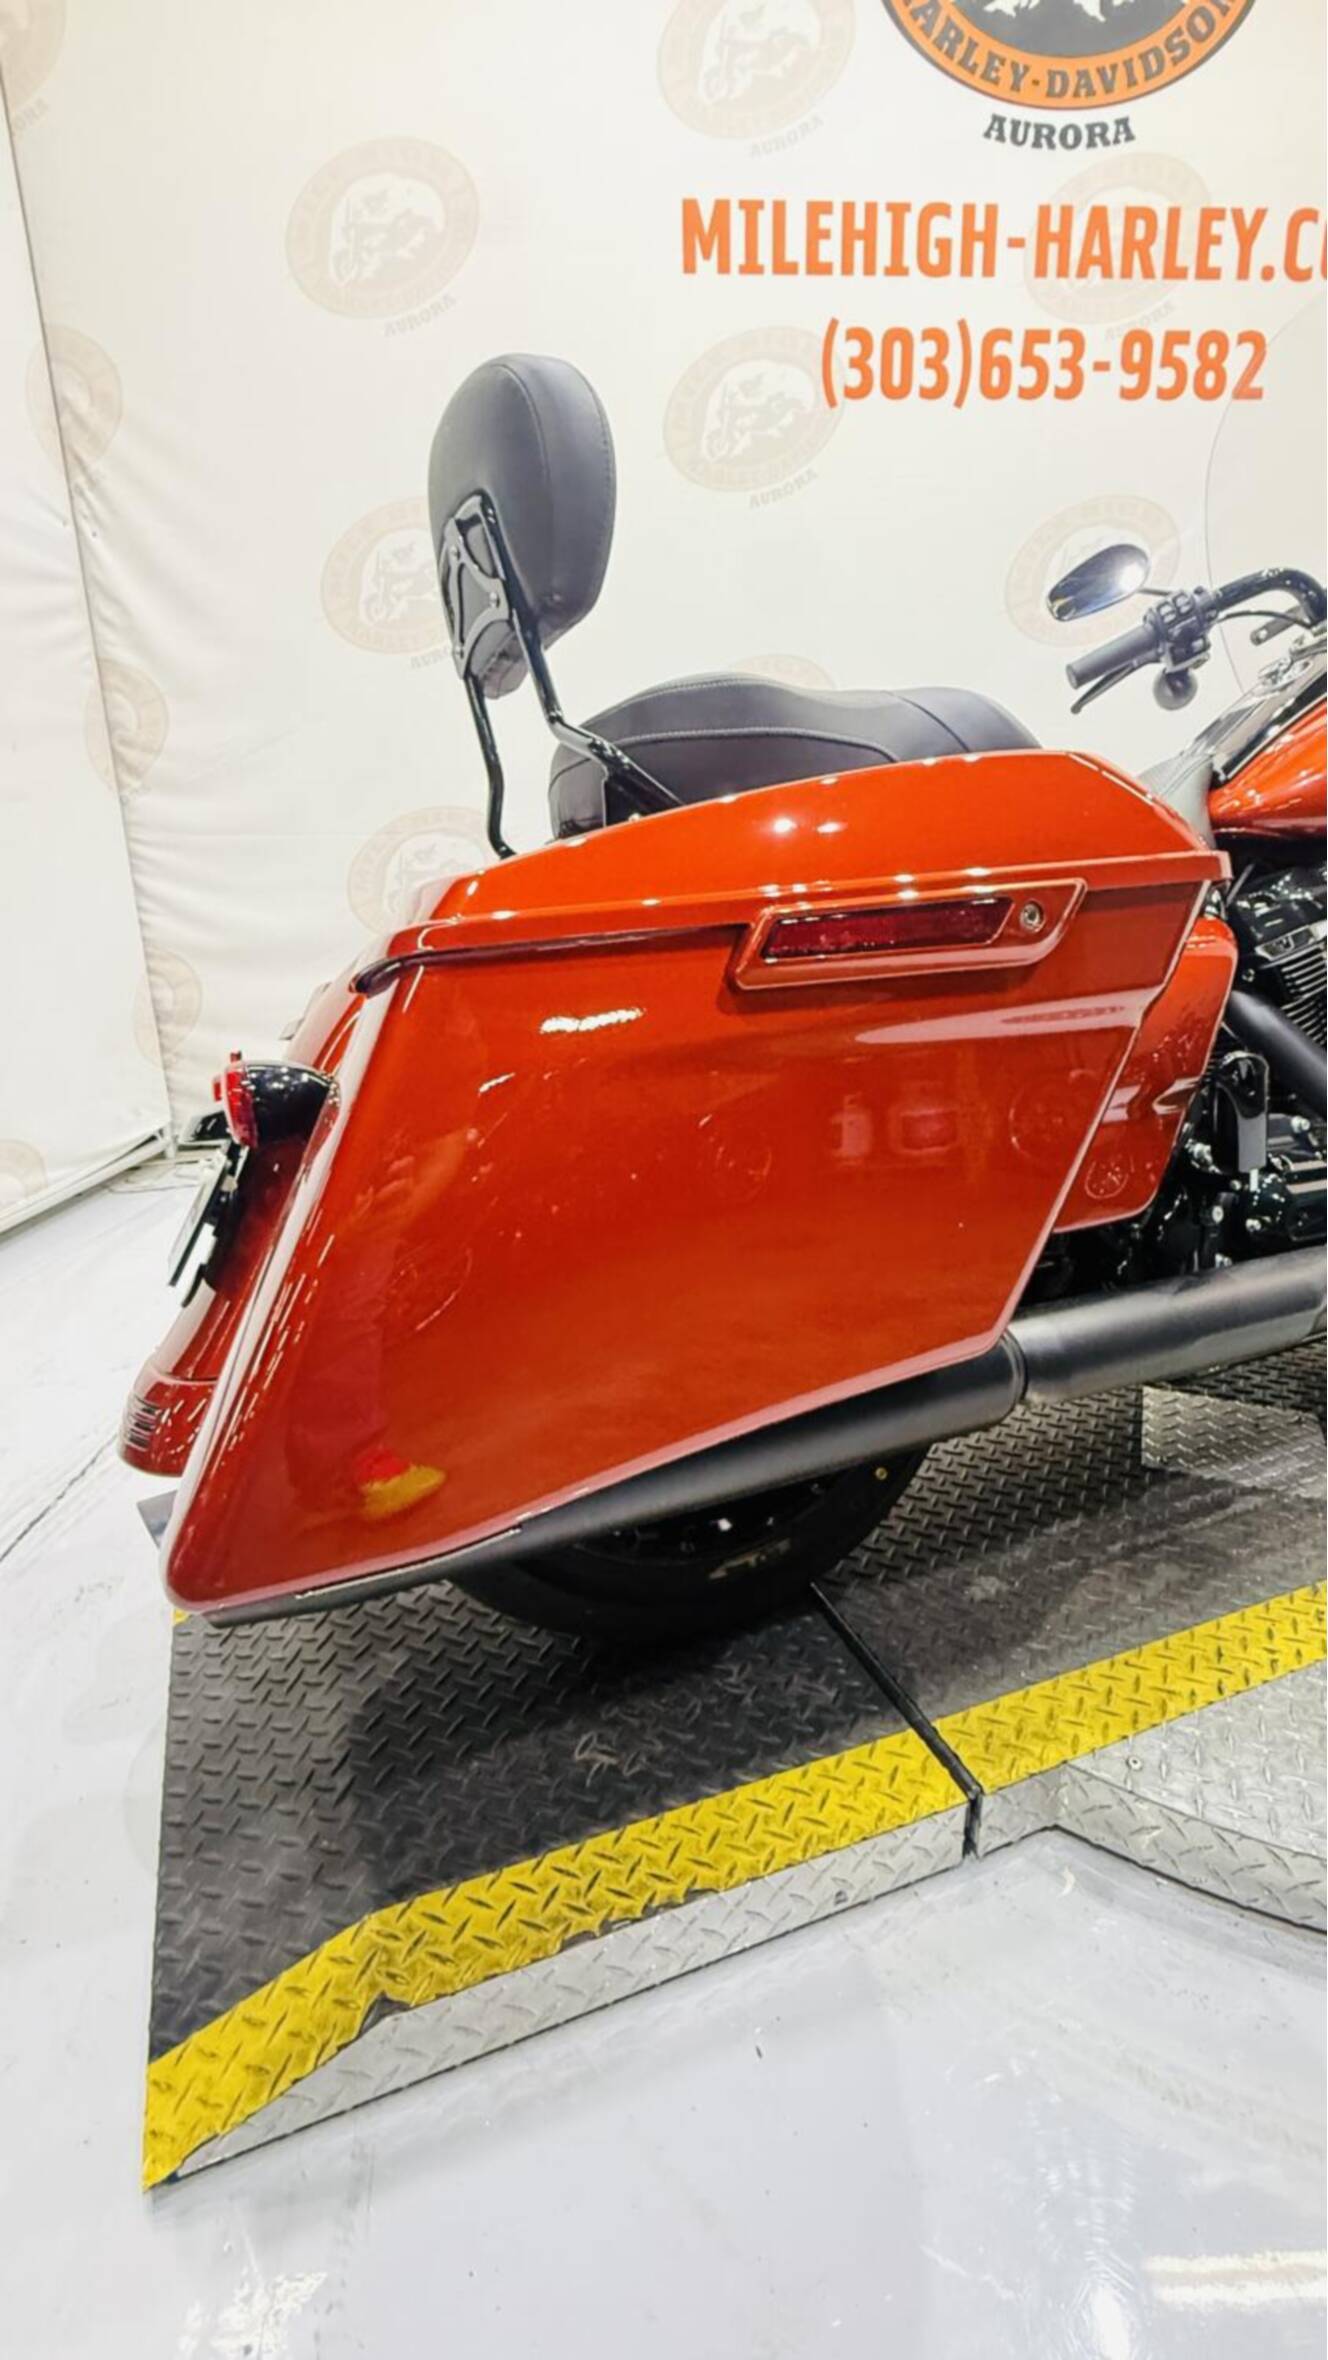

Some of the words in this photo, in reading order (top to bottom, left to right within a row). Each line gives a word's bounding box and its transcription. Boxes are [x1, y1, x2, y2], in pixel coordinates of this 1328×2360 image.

[902, 0, 1234, 99] ARLEY-DAVIDSO
[983, 113, 1136, 151] AURORA
[384, 293, 457, 338] AURORA
[822, 319, 1268, 409] (303)653-9582
[749, 468, 818, 510] AURORA
